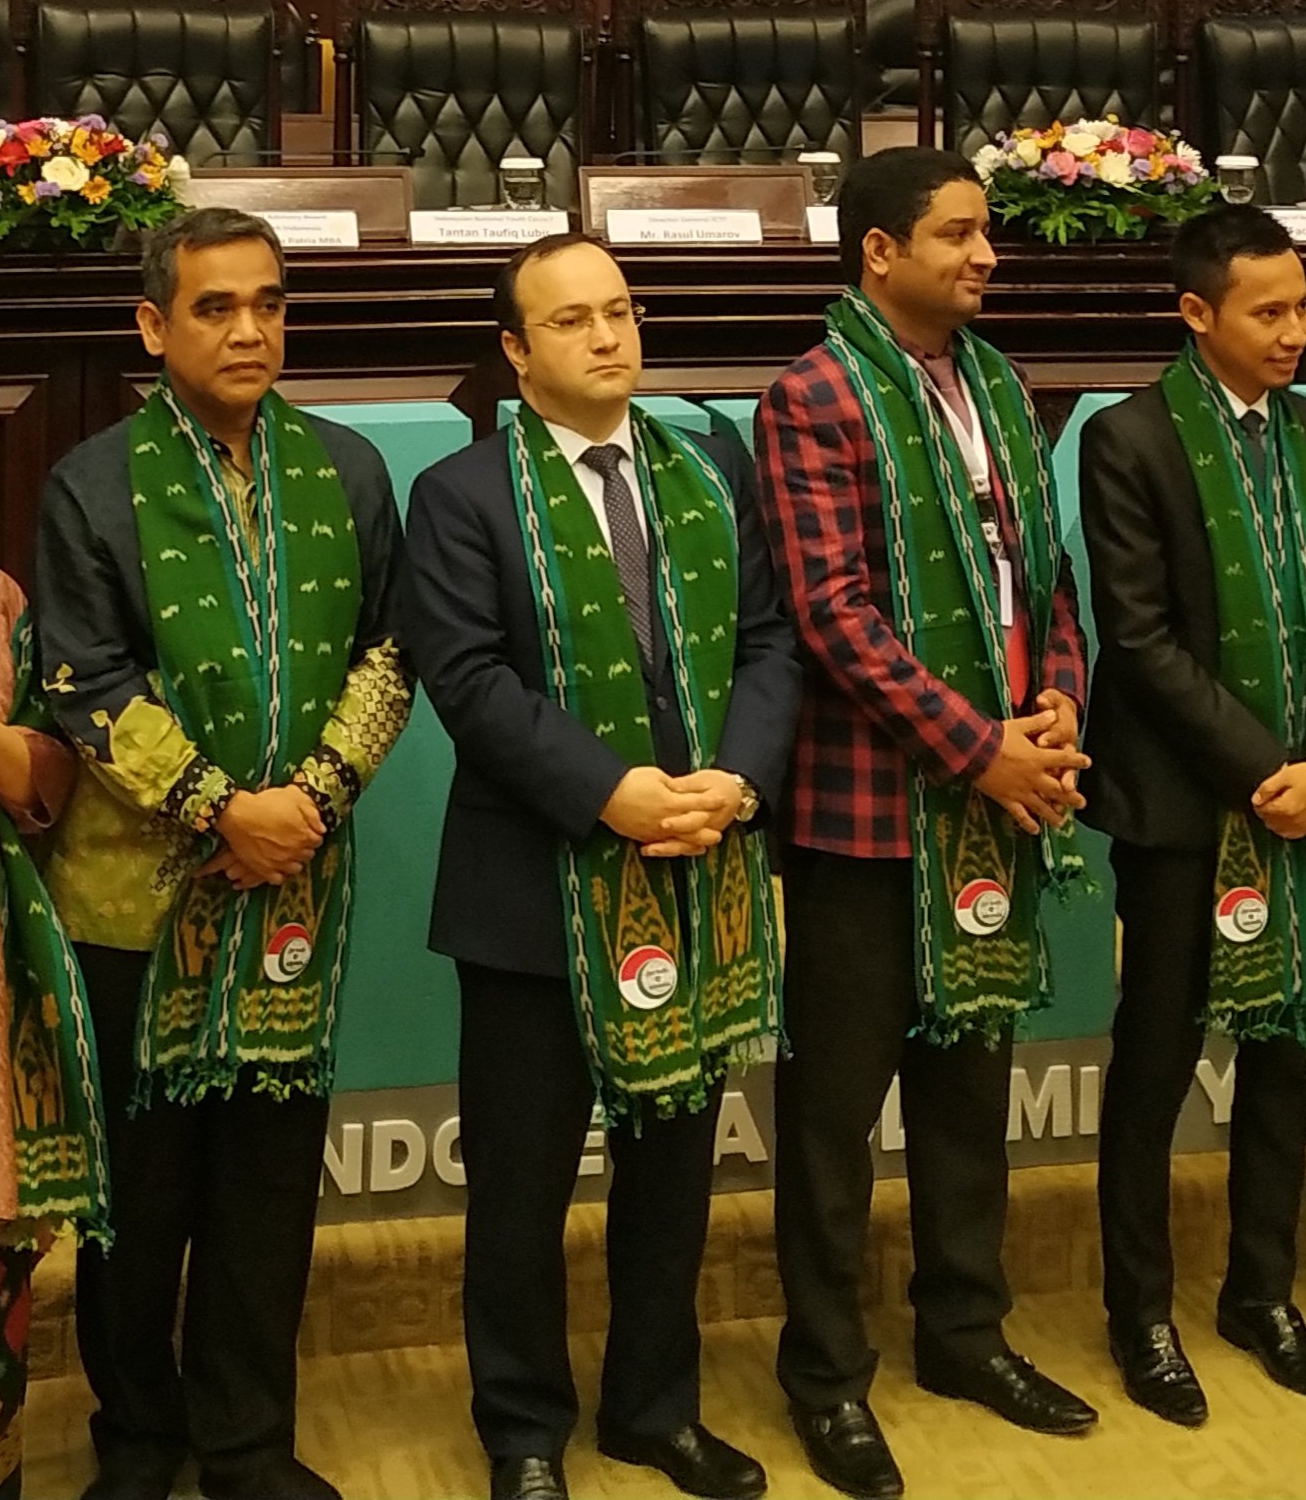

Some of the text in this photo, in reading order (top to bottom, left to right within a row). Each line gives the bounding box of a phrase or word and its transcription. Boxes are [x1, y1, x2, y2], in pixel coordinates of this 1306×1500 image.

[439, 227, 479, 237] Tantan
[483, 227, 519, 239] Taufiq
[640, 229, 740, 239] Mr. Rasul Umarov
